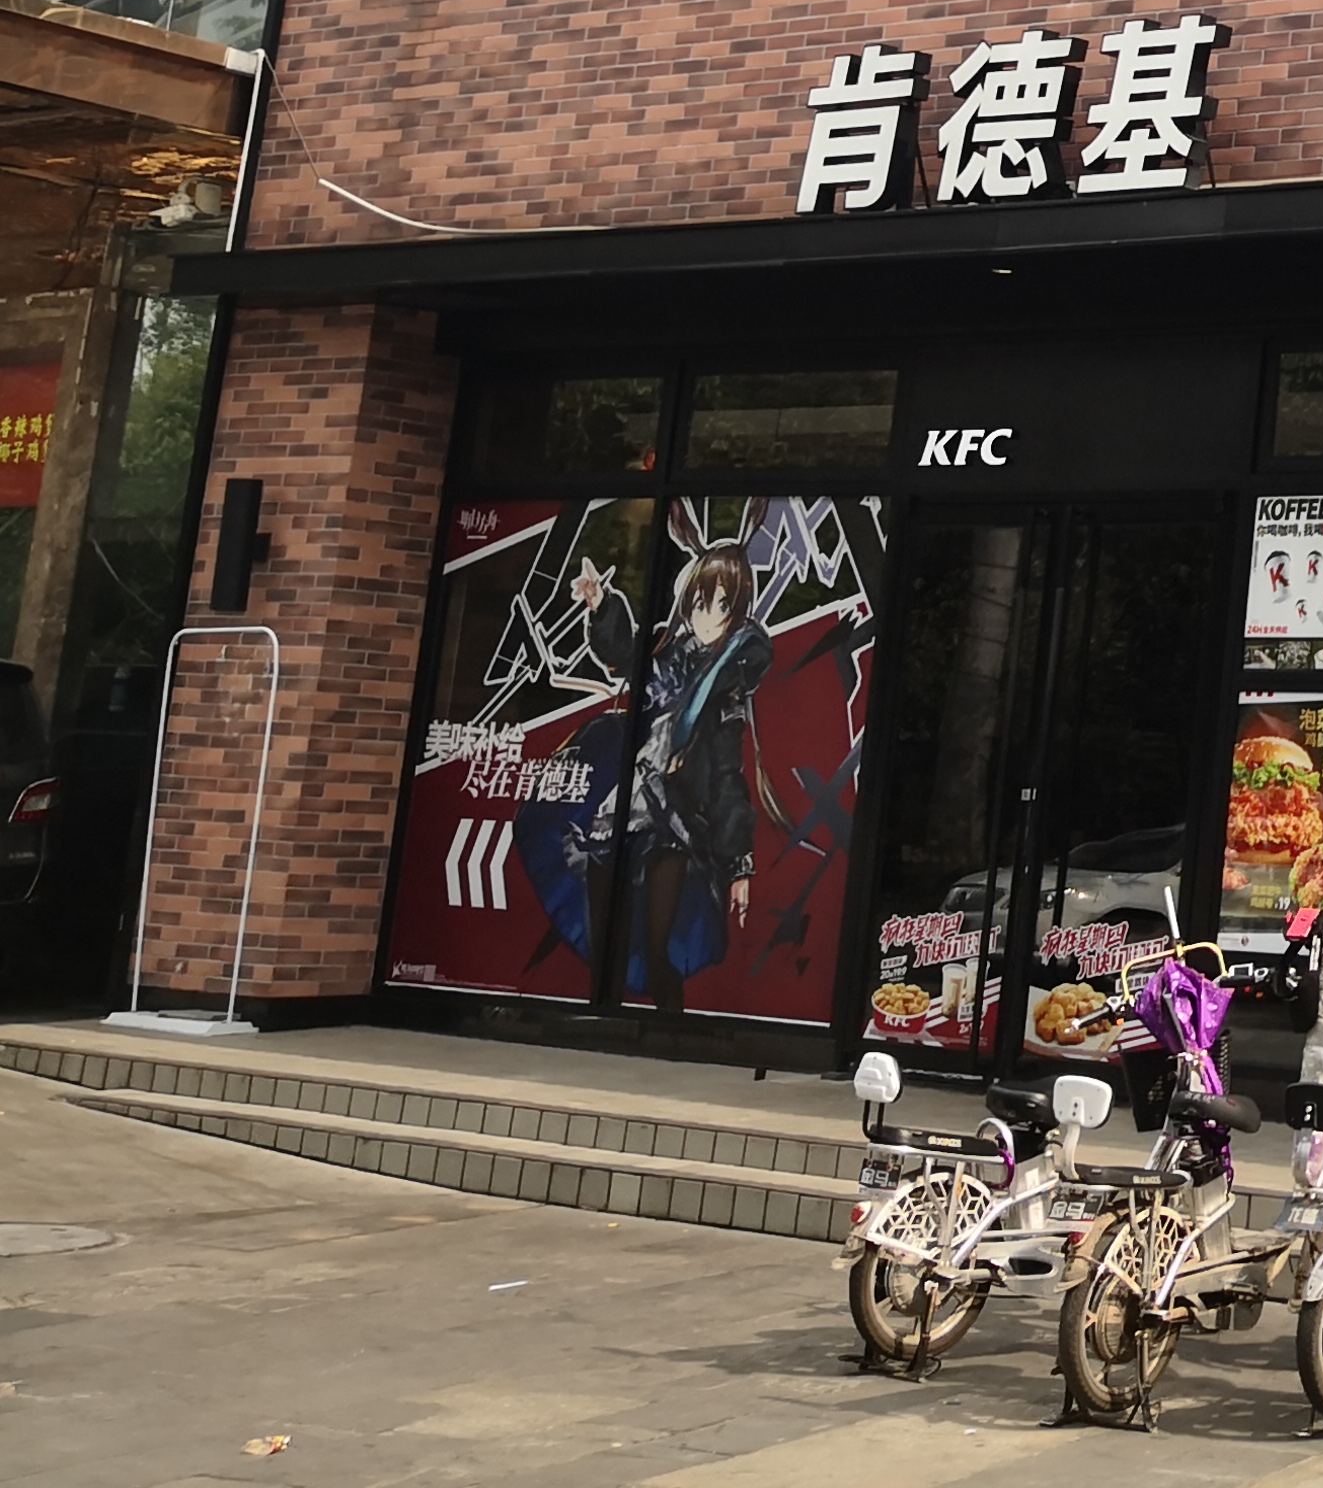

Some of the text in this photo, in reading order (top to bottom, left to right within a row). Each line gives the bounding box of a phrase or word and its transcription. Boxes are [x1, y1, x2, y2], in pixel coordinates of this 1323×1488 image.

[796, 14, 1217, 213] 肯德基
[918, 428, 1013, 467] KFC
[423, 719, 527, 763] 美味补给
[460, 758, 594, 804] 尽在肯德基
